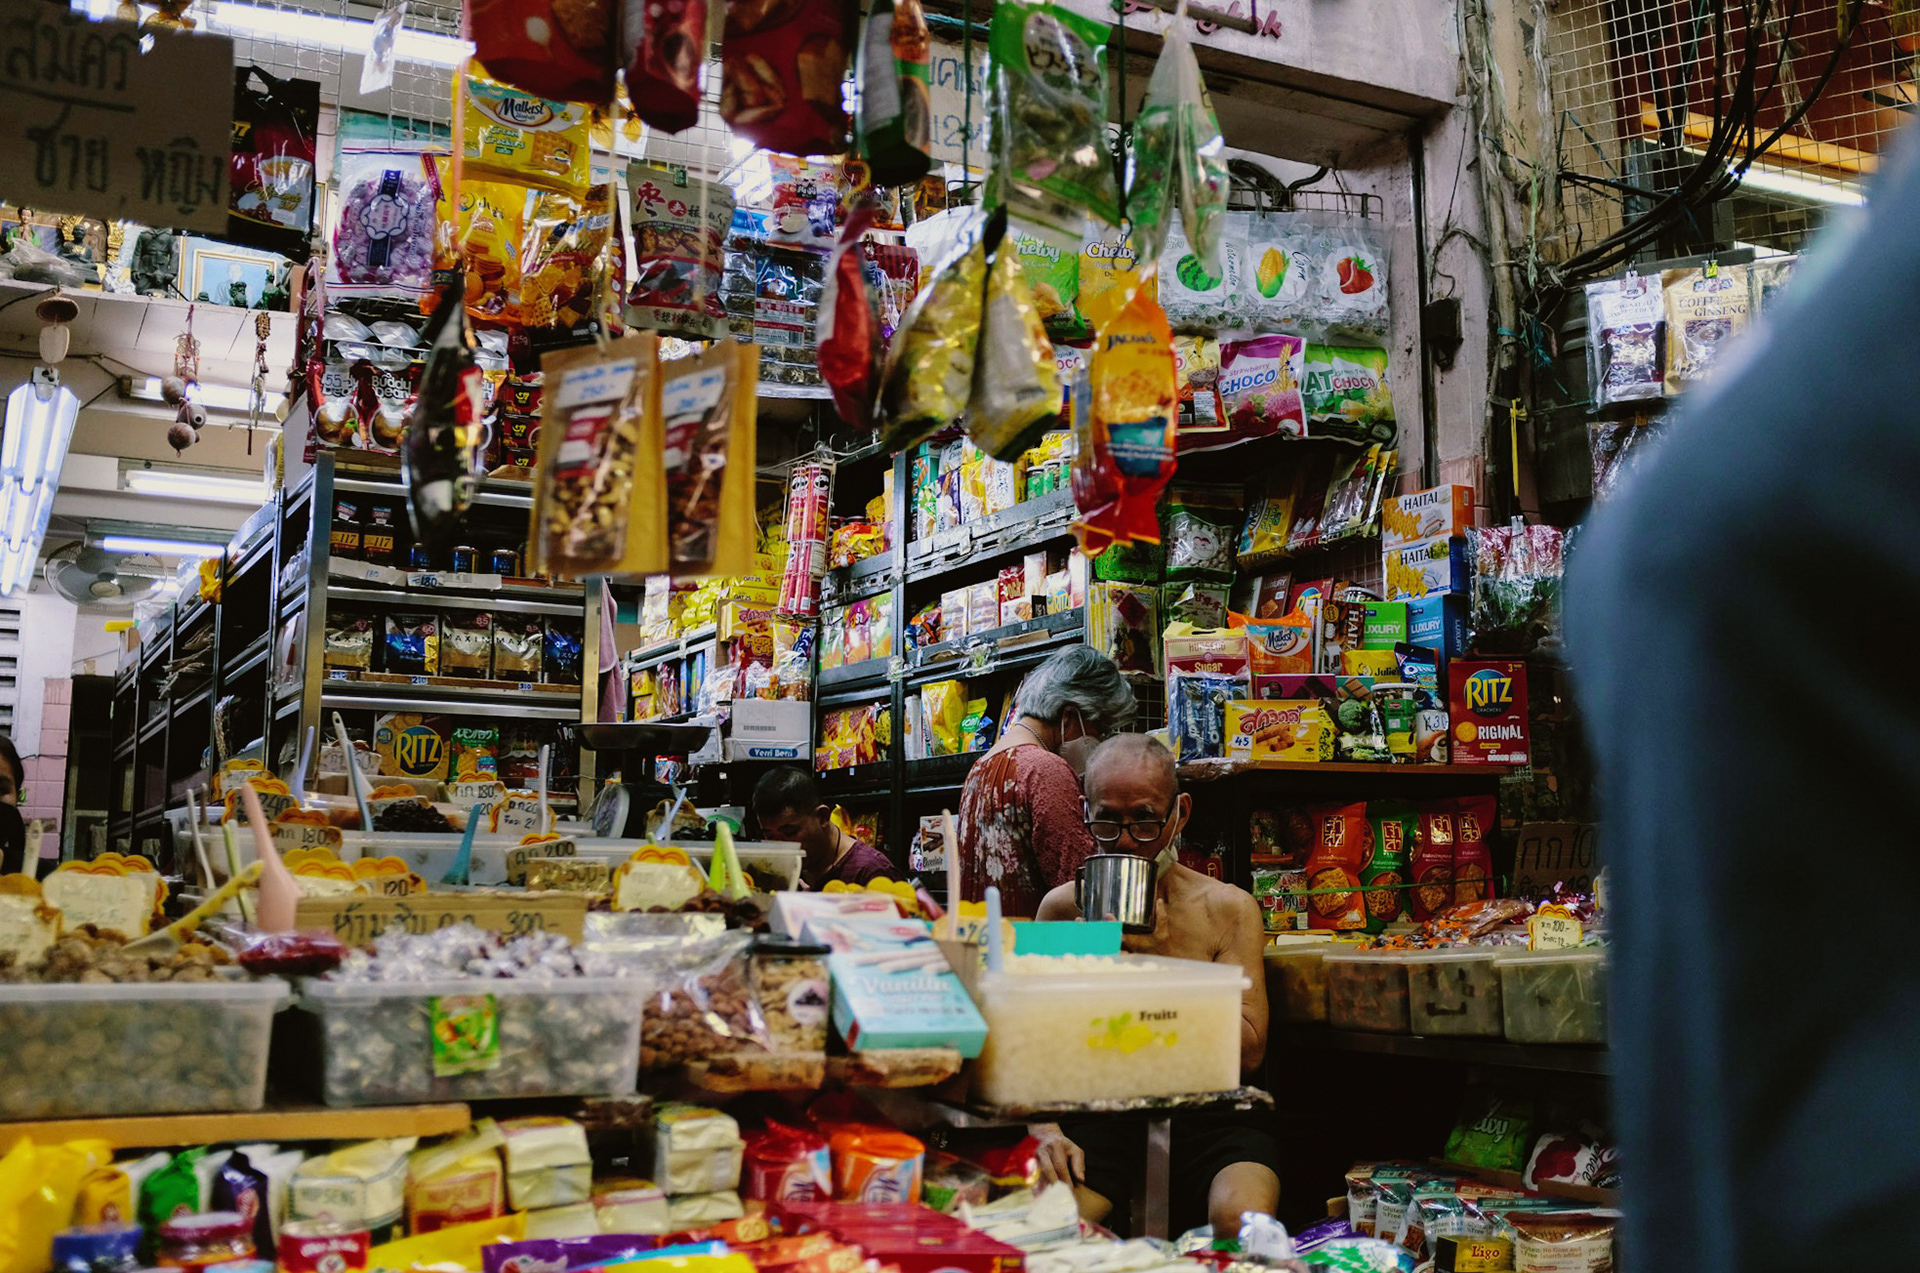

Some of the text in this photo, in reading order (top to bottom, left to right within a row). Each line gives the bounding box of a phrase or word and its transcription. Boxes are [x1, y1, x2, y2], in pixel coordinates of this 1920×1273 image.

[499, 97, 545, 122] Malkist
[1291, 251, 1307, 281] Corn
[371, 373, 412, 393] Buddy
[1221, 369, 1277, 395] CHOCO
[1334, 376, 1376, 390] CHOCO
[1404, 491, 1438, 510] HAITAI
[340, 532, 357, 544] 117
[374, 537, 391, 548] 117
[1400, 547, 1434, 566] HAITAI
[1363, 624, 1402, 634] UXURY
[1411, 620, 1441, 634] LUXURY
[1194, 661, 1224, 673] Sugar
[1466, 677, 1513, 711] RITZ
[1235, 736, 1250, 746] 45
[396, 730, 442, 769] RITZ
[1138, 1009, 1178, 1022] Fruits
[1471, 1244, 1500, 1260] Ligo
